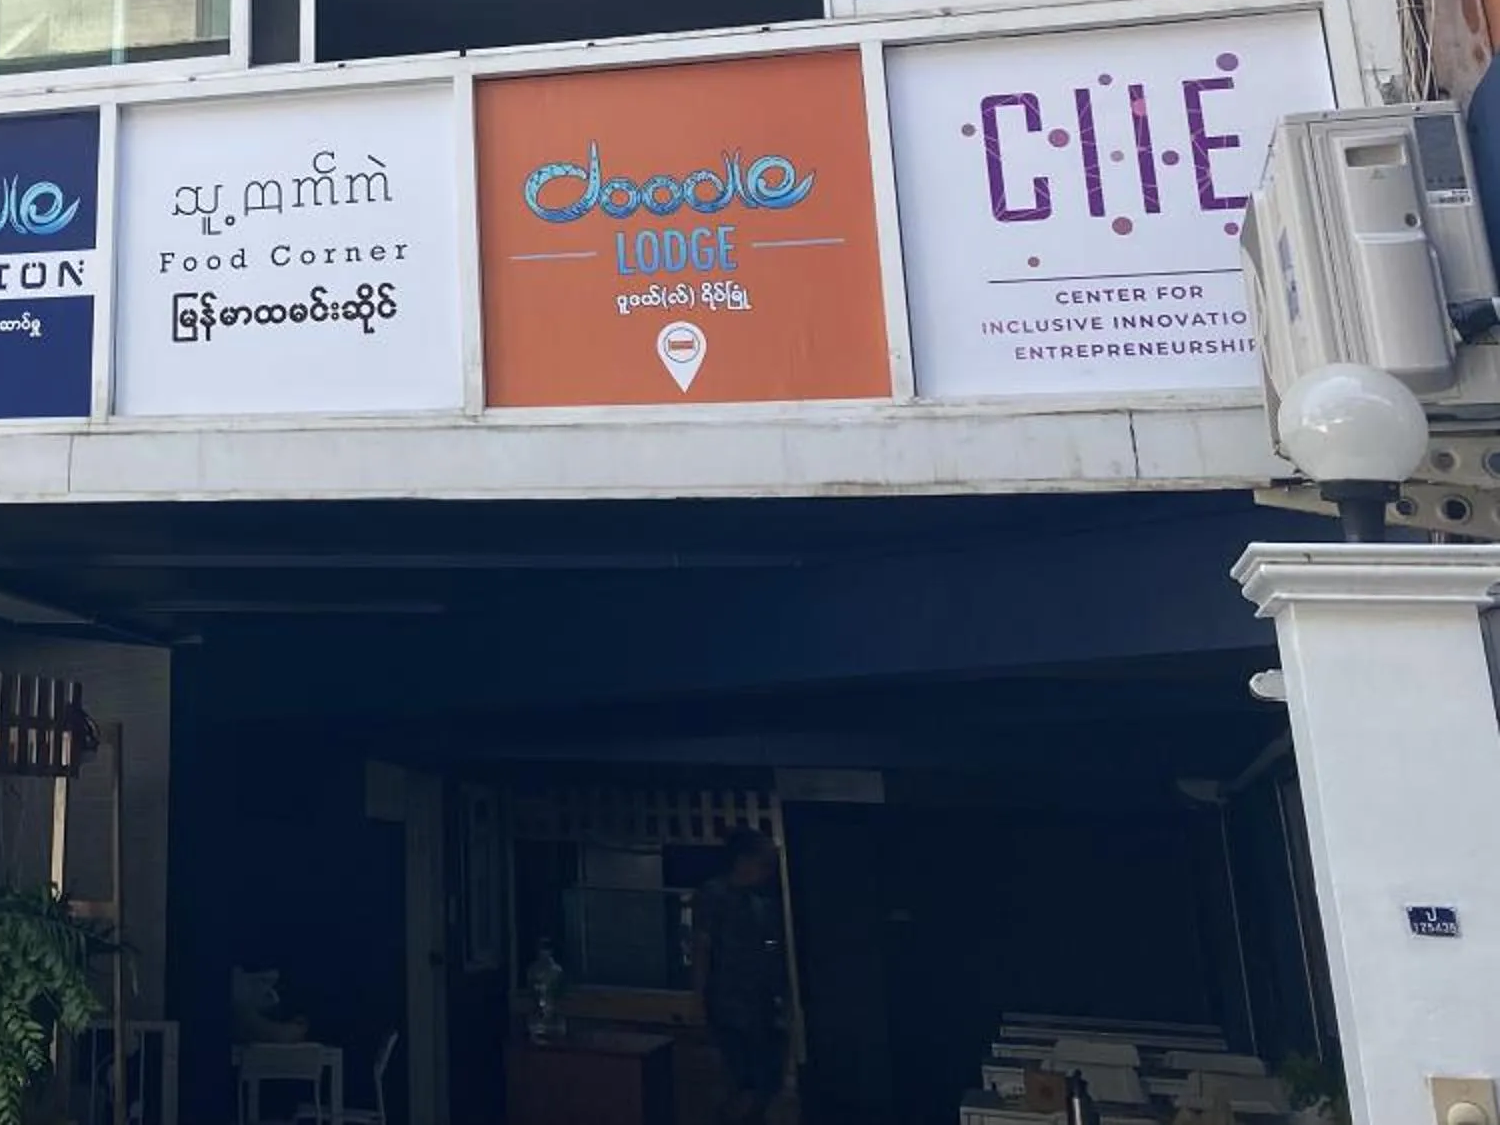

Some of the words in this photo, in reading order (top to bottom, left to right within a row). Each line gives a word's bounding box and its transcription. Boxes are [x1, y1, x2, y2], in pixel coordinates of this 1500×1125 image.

[523, 139, 816, 223] doodle
[159, 248, 248, 274] Food
[271, 242, 408, 267] Corner
[615, 225, 739, 276] LODGE
[1055, 288, 1147, 305] CENTER
[1157, 285, 1204, 300] FOR
[981, 316, 1104, 335] INCLUSIVE
[1113, 310, 1247, 329] INNOVATIO
